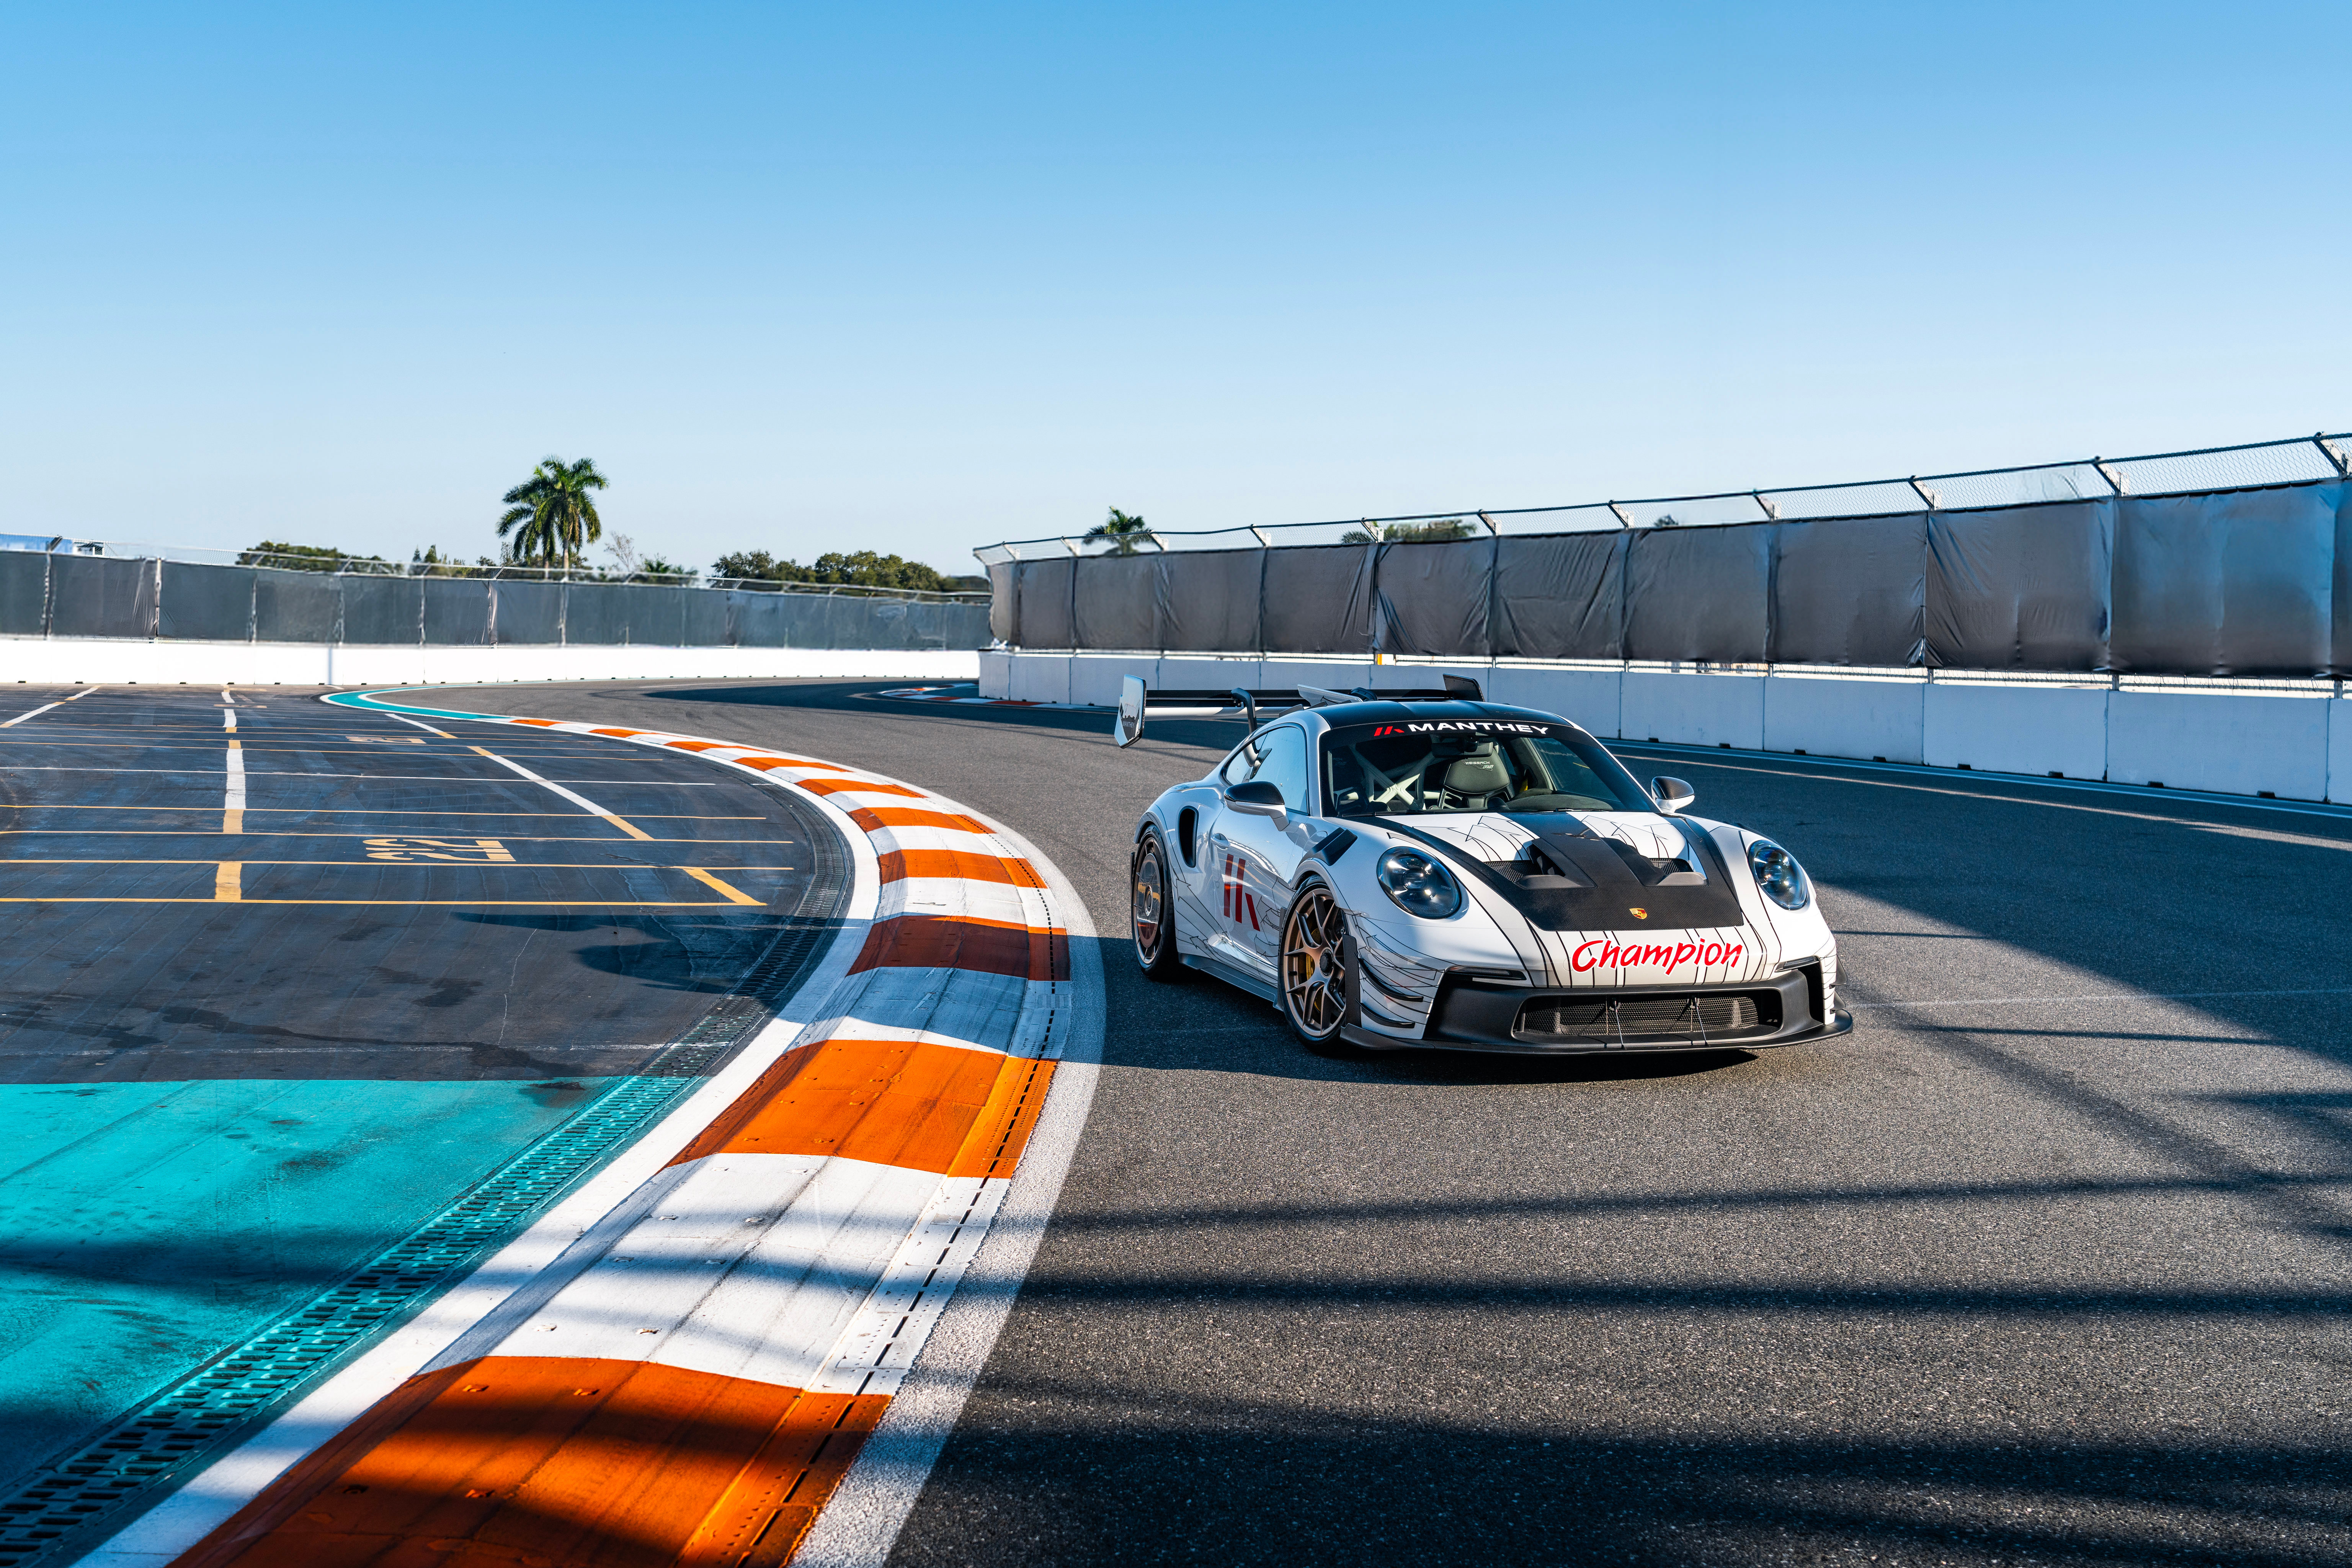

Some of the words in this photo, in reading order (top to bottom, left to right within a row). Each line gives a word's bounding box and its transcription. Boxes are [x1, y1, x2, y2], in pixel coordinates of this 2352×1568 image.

[1408, 722, 1548, 734] MANTHEY
[363, 839, 516, 862] 212
[1572, 938, 1743, 975] Champion
